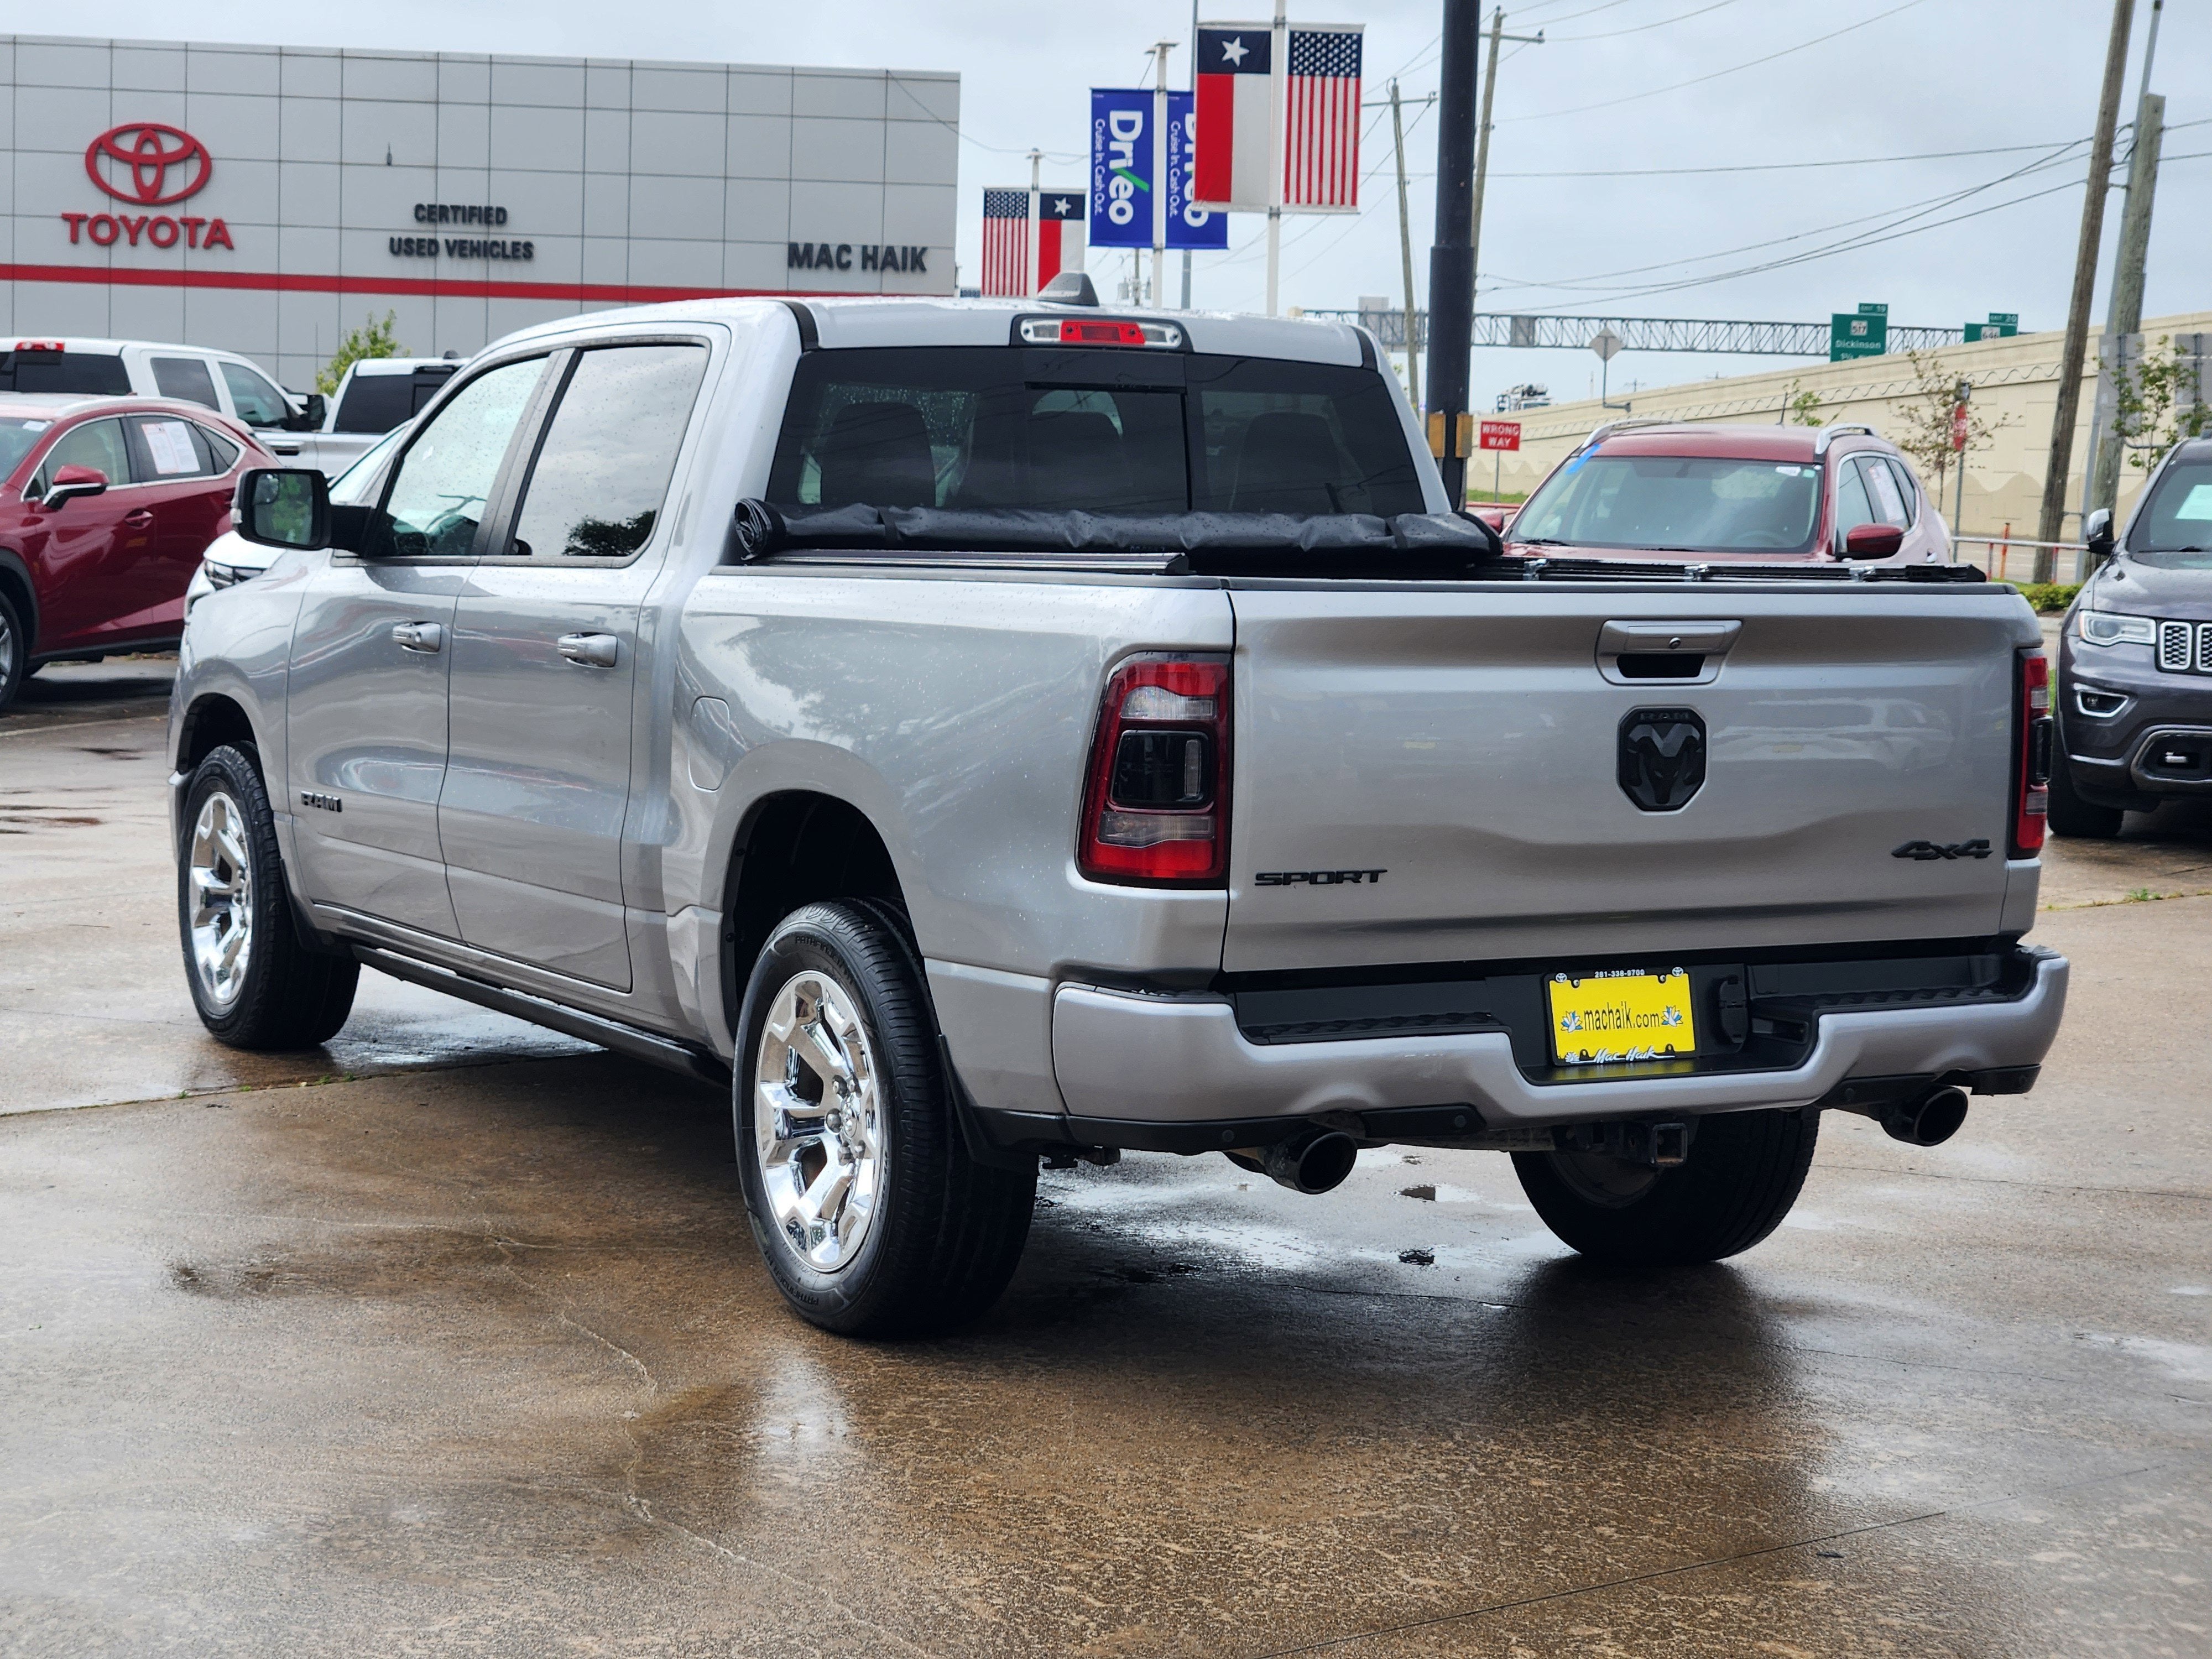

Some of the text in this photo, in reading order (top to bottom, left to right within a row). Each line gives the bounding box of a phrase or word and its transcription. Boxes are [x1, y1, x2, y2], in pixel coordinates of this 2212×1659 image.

[1095, 118, 1105, 151] Cruise
[1170, 121, 1181, 153] Cruise
[1095, 165, 1105, 191] Cash
[1170, 168, 1180, 194] Cash
[414, 203, 508, 226] CERTIFIED
[62, 212, 234, 251] TOYOTA
[389, 237, 534, 262] USED VEHICLES
[788, 242, 928, 273] MAC HAIK
[1852, 326, 1867, 334] 517
[1835, 339, 1881, 349] Dickinson
[1483, 424, 1519, 436] WRONG
[1489, 436, 1511, 447] WAY
[1639, 712, 1690, 721] RAM
[301, 790, 343, 813] RAM
[1254, 869, 1388, 886] SPORT
[1594, 969, 1645, 978] 281-338-9700
[1583, 1001, 1660, 1031] machaik.com
[1593, 1045, 1665, 1063] Mac Haik
